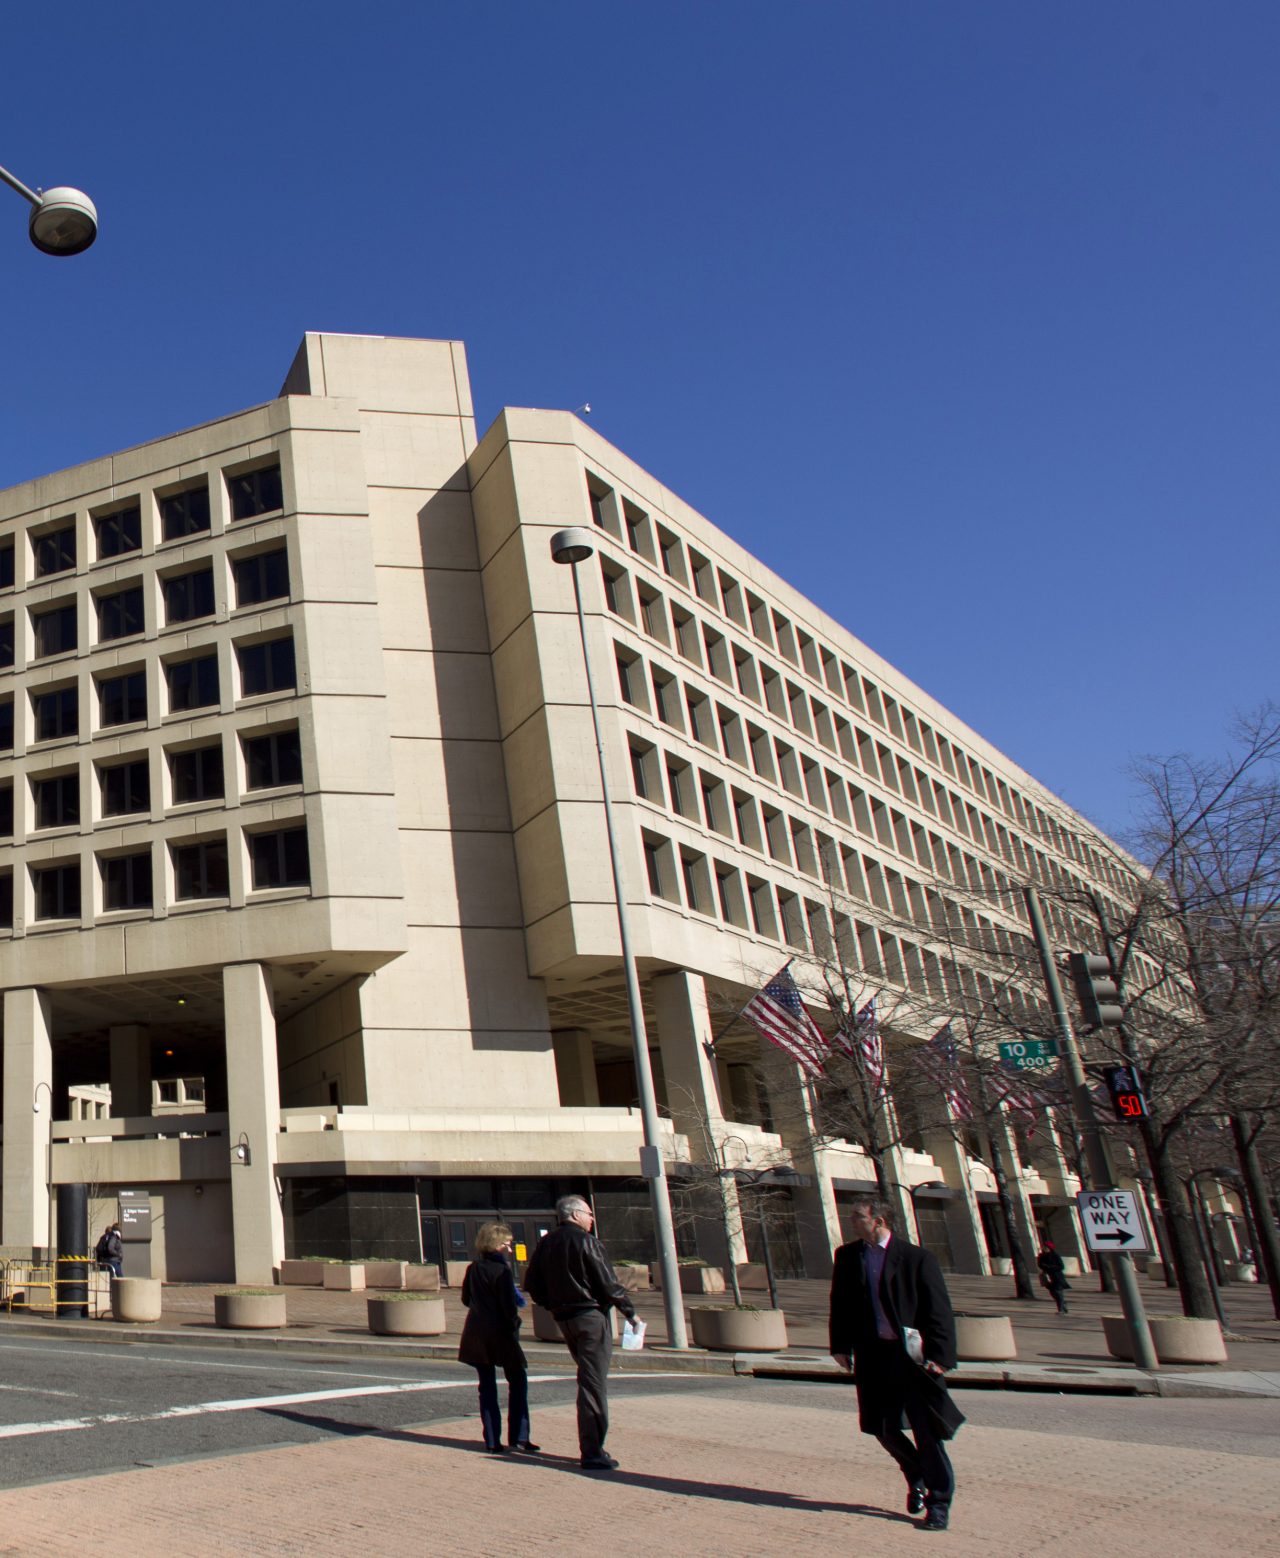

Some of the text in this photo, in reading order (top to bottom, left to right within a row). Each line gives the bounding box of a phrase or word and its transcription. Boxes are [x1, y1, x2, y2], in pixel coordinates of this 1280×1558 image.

[1004, 1043, 1027, 1057] 10
[1017, 1057, 1044, 1067] 400
[1119, 1095, 1141, 1116] 50
[1088, 1195, 1128, 1209] ONE
[1090, 1211, 1130, 1225] WAY
